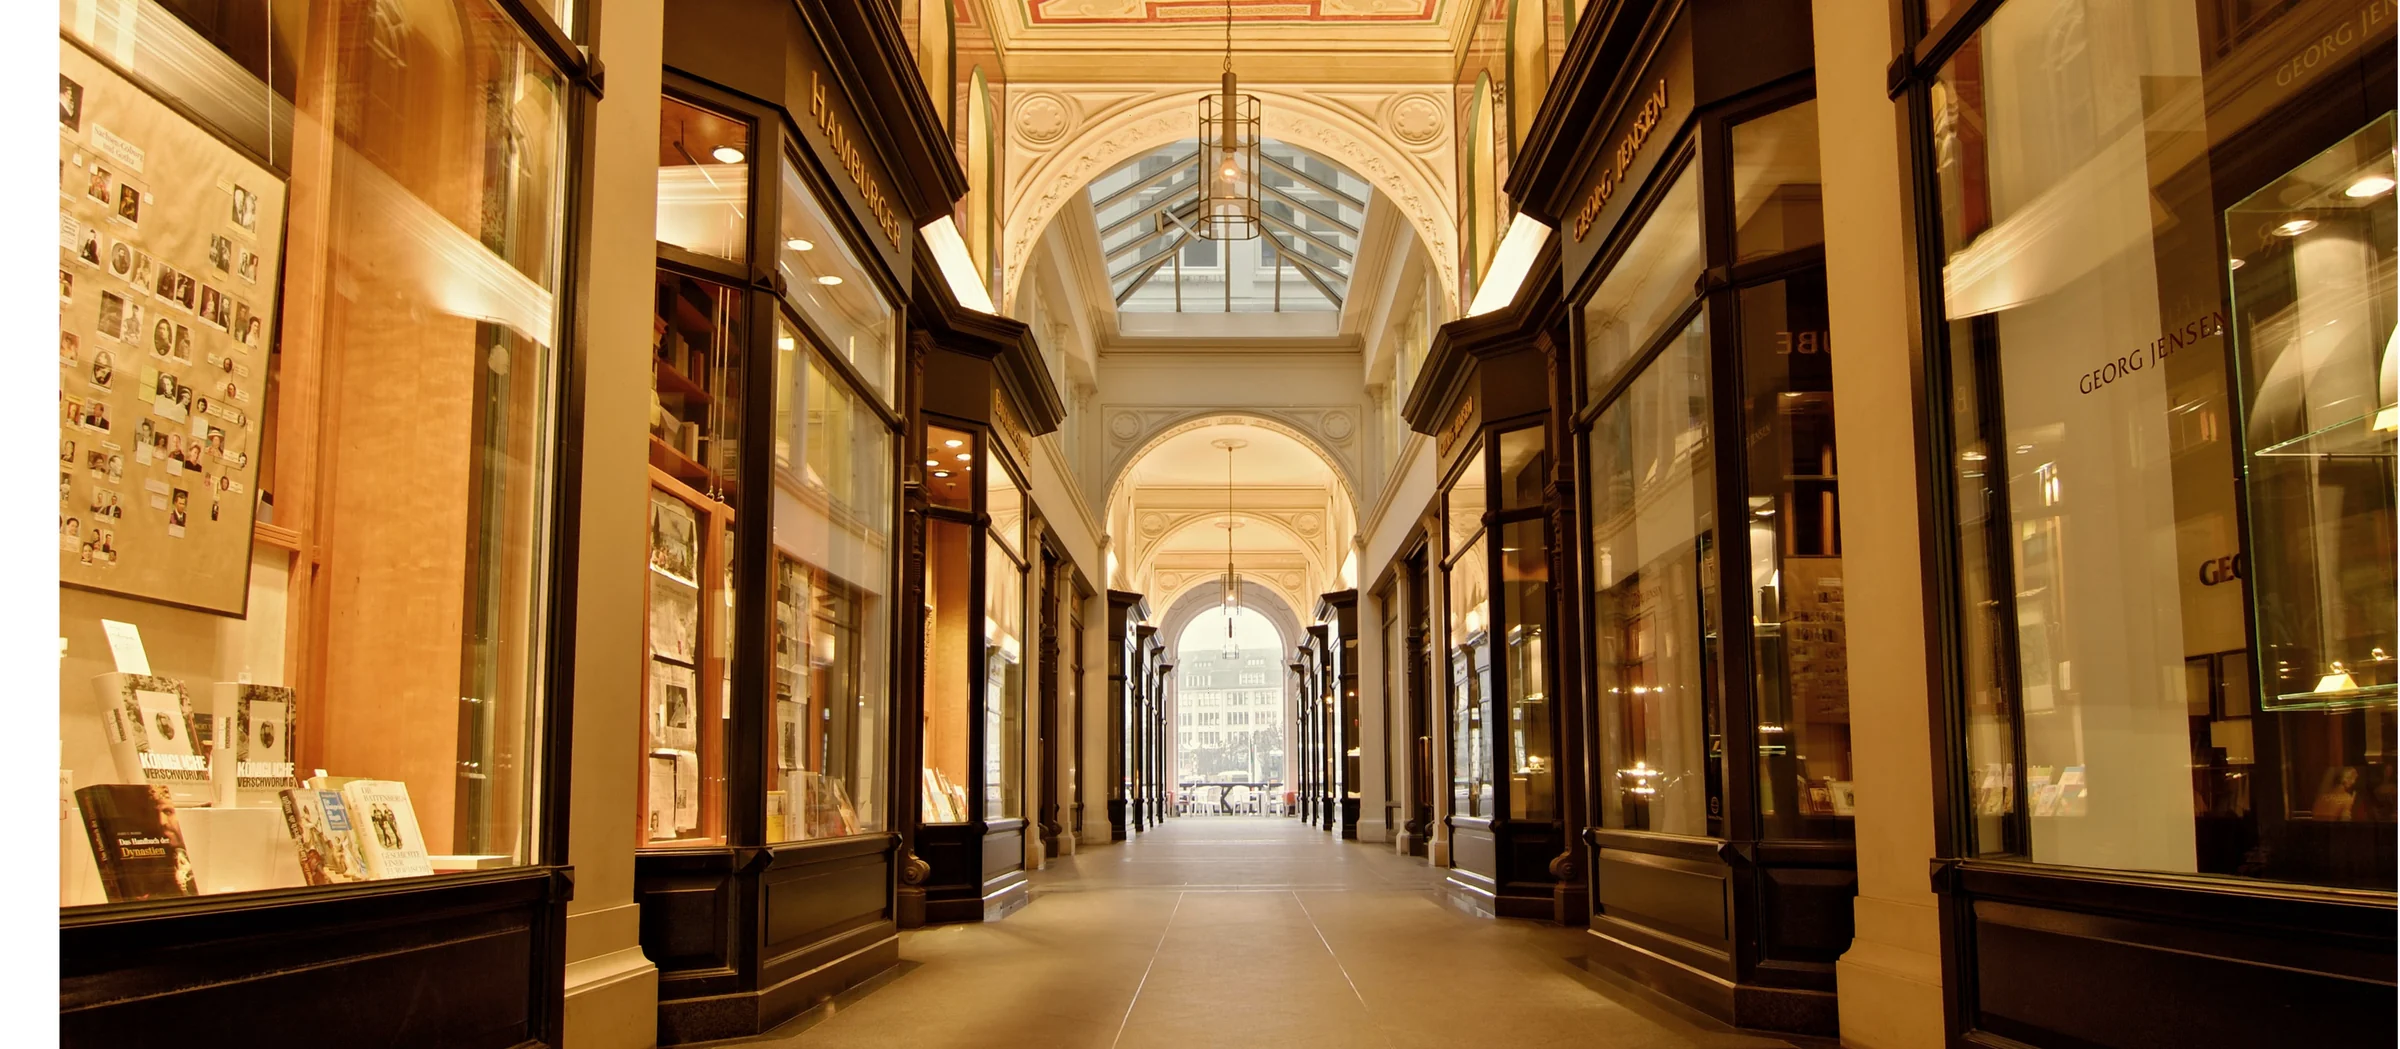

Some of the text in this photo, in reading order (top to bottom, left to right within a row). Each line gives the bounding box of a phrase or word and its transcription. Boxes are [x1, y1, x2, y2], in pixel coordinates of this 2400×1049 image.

[2276, 22, 2352, 87] GEORG
[811, 70, 901, 253] HAMBURGER
[1573, 79, 1667, 243] GEORG JENSEN
[2079, 311, 2225, 395] GEORG JENSEN
[138, 748, 208, 771] KÖNIGLICHE
[237, 759, 294, 777] KÖNIGLICHE
[118, 838, 132, 846] Das
[131, 837, 160, 845] Handbuch
[120, 846, 167, 859] Dynastien
